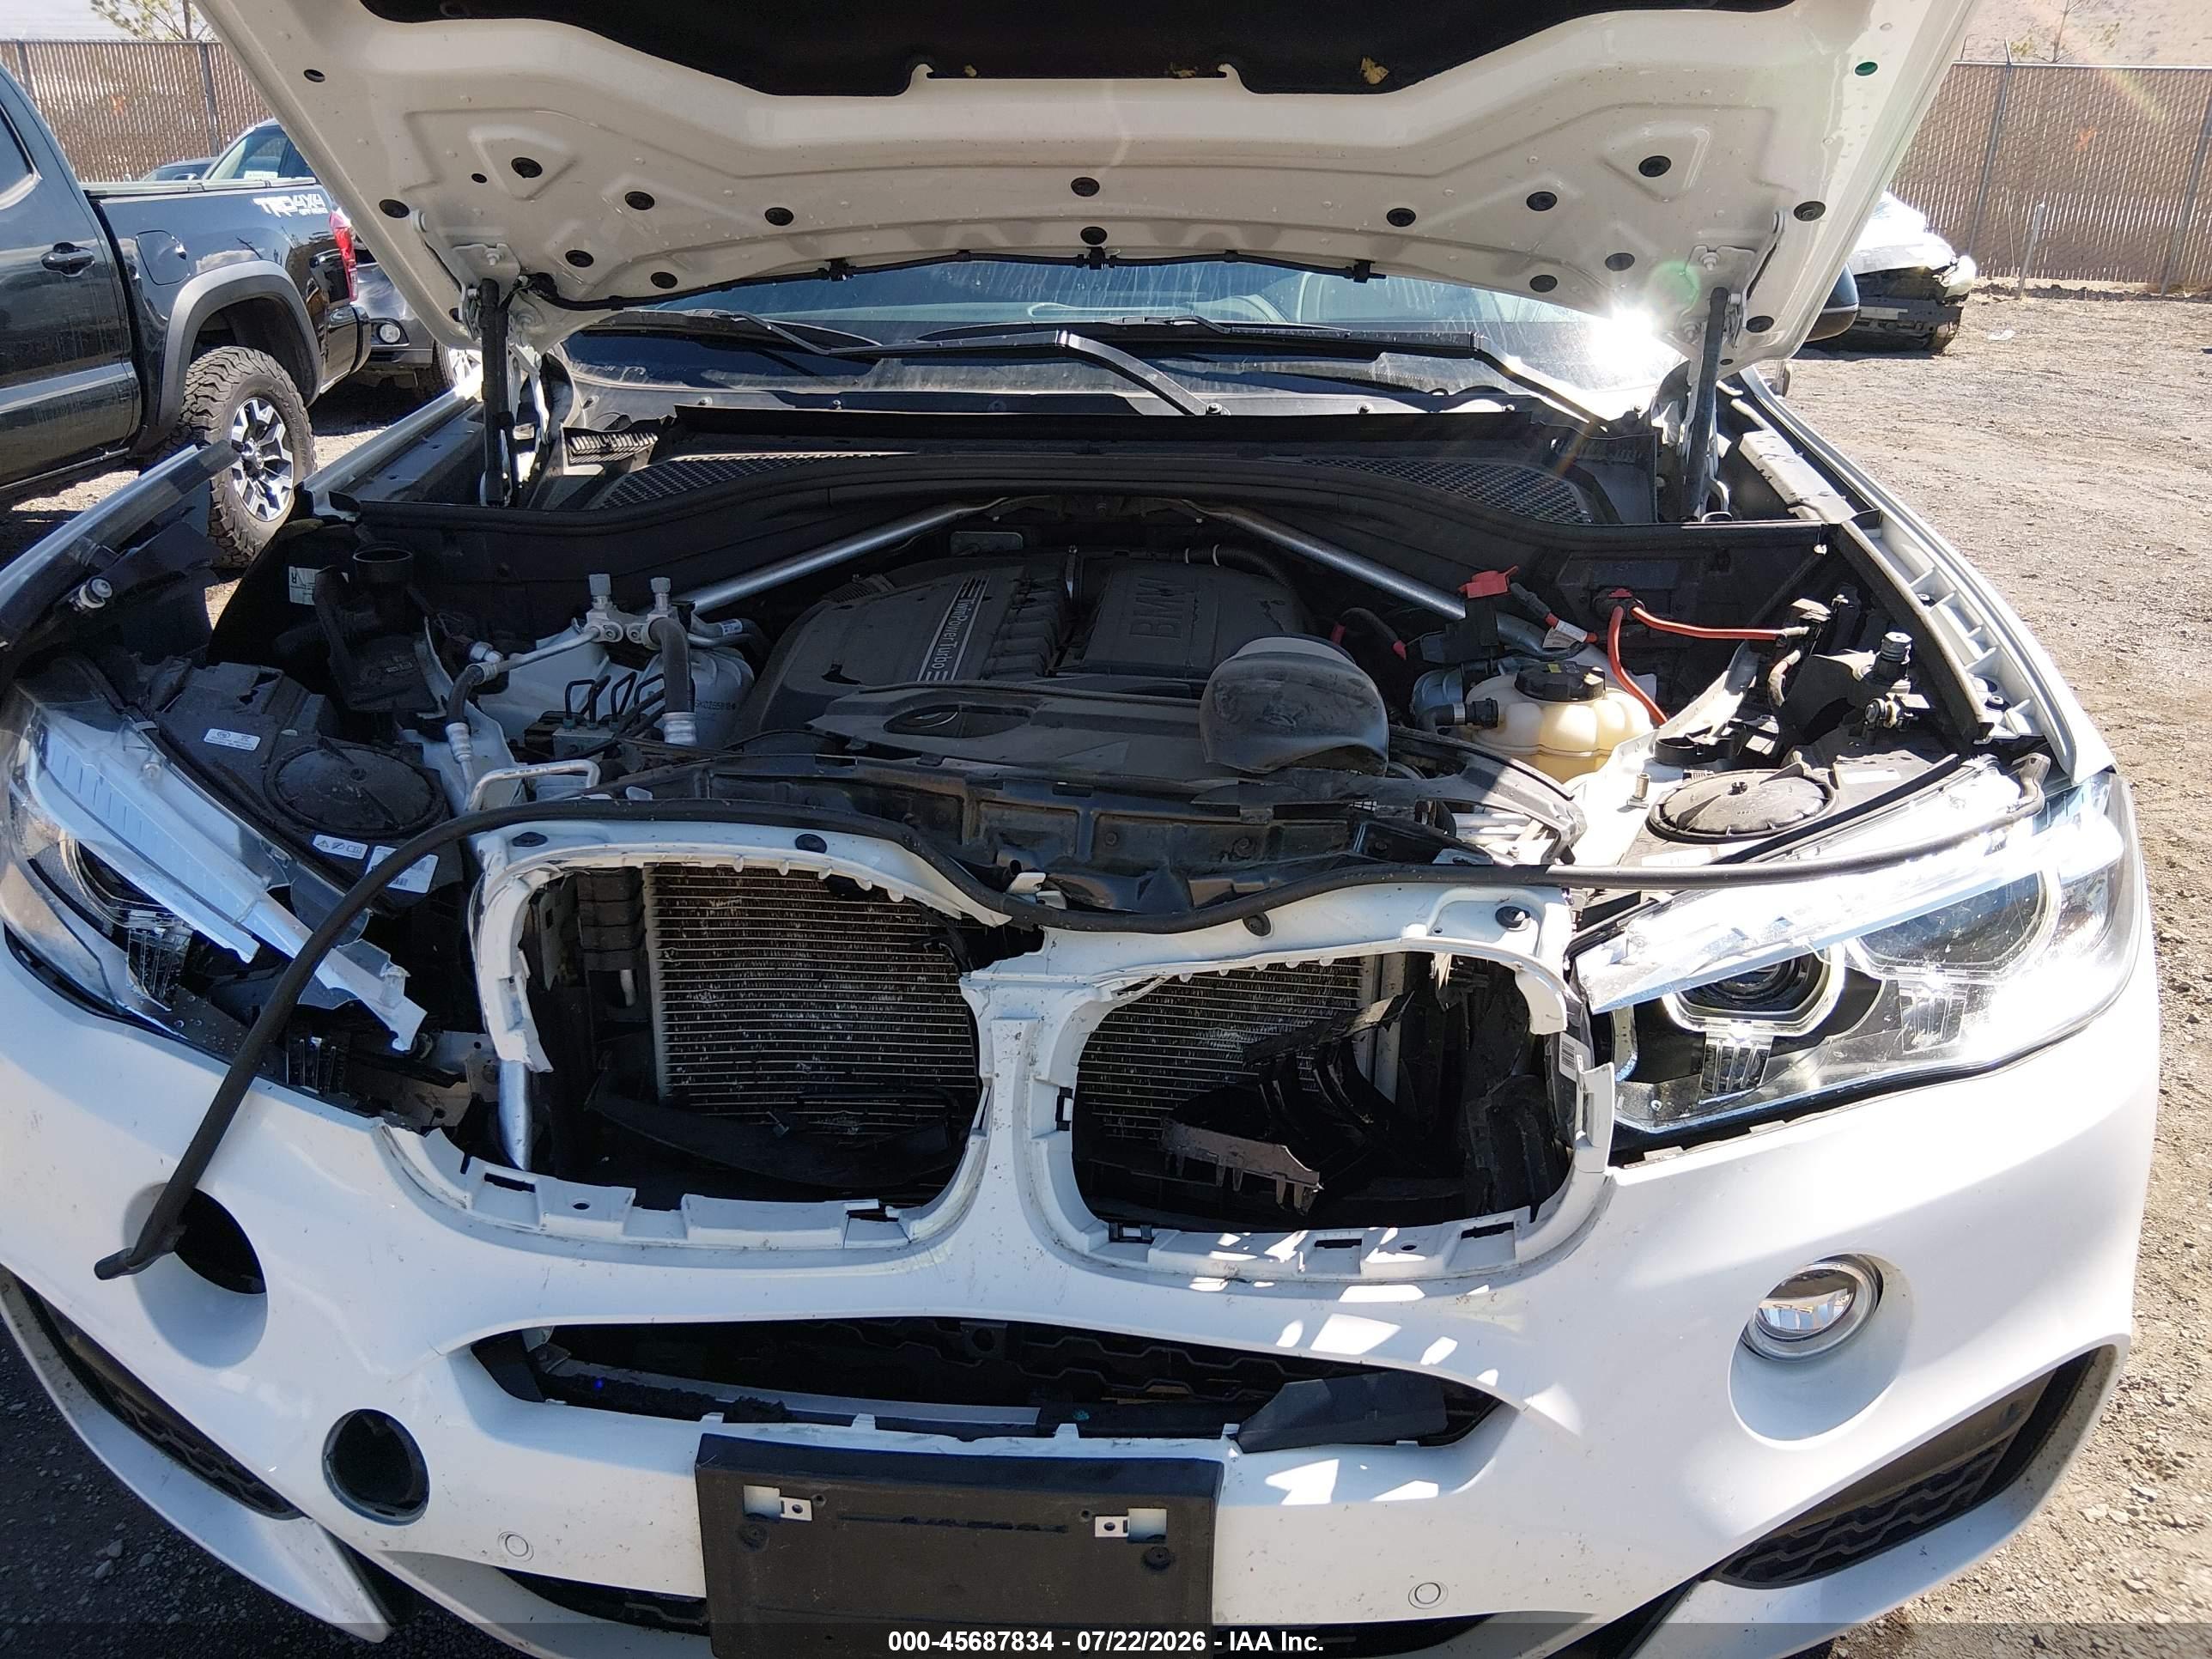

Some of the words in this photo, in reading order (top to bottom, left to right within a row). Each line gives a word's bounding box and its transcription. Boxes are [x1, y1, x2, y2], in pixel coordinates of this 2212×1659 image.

[252, 196, 298, 217] TRD
[293, 193, 326, 208] 4X4
[943, 598, 976, 641] TwinPower
[1130, 577, 1188, 638] BMW
[931, 641, 958, 669] Turbo
